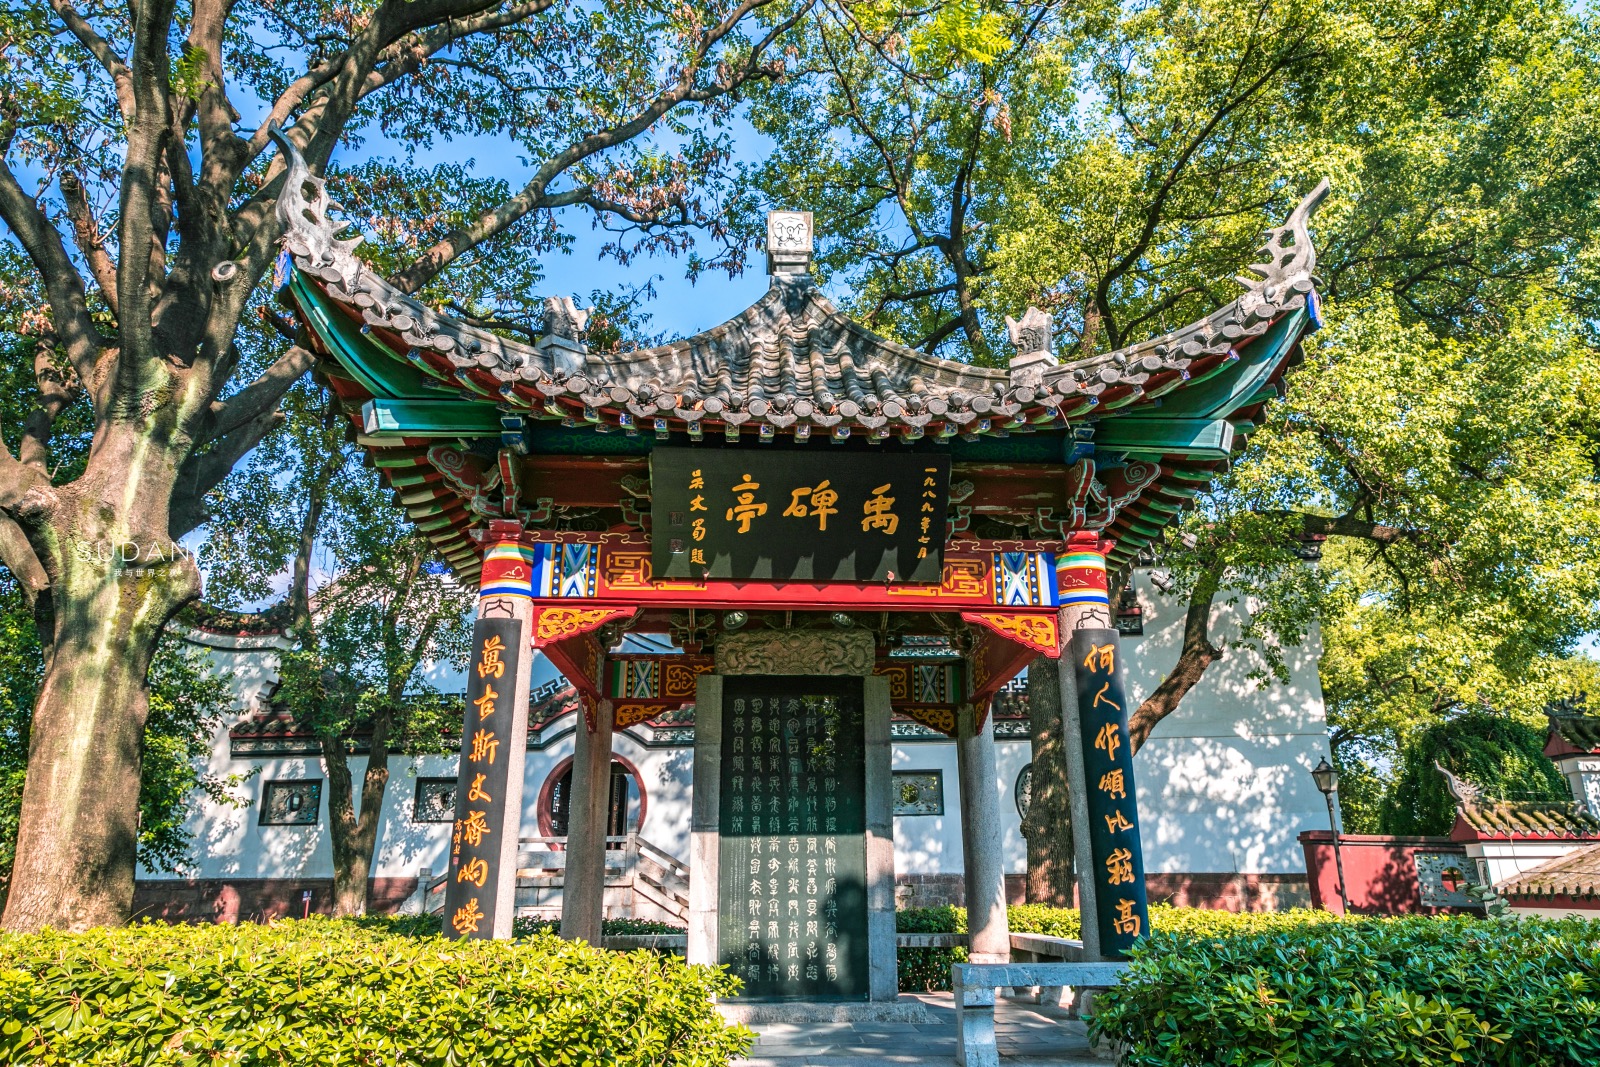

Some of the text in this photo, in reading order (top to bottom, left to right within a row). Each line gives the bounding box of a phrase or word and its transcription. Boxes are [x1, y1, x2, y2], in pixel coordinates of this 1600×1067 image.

[726, 474, 899, 534] 禹碑亭
[917, 467, 937, 558] 一九八九年七月
